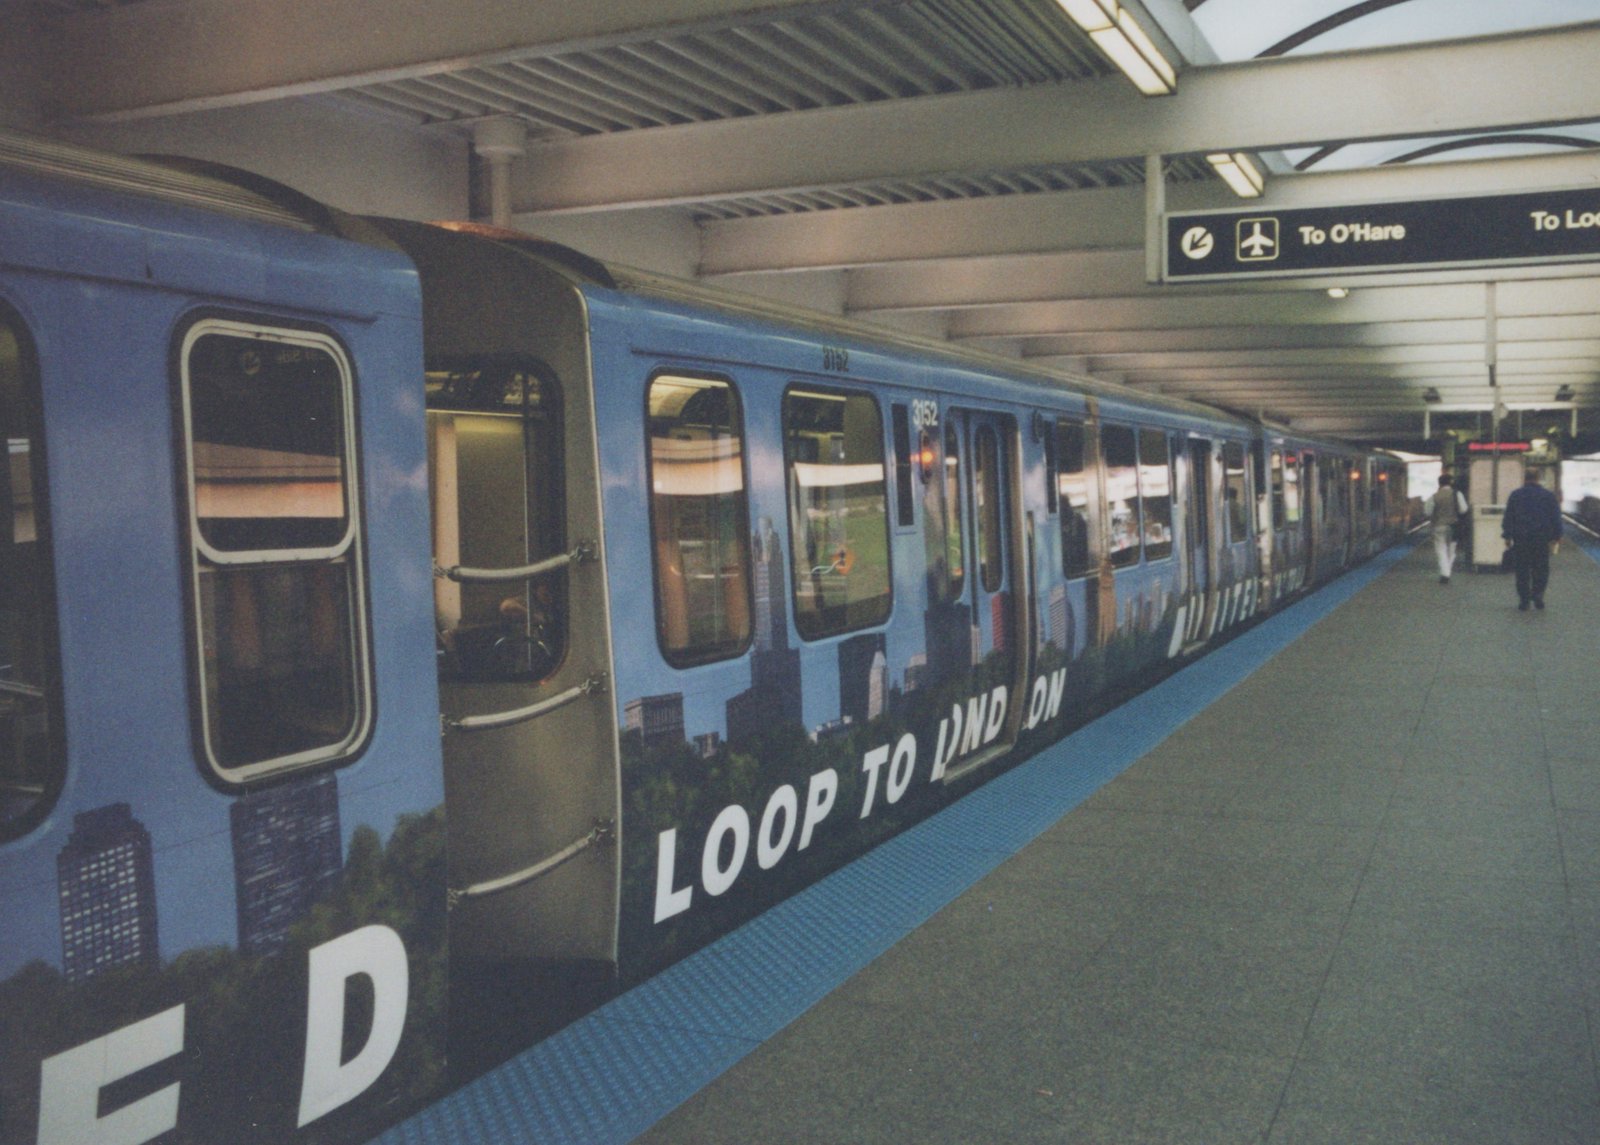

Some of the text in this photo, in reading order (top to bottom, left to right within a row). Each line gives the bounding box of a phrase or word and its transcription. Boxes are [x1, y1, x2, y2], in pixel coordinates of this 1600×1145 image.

[1531, 210, 1560, 231] To
[1299, 222, 1406, 245] To O'Hare
[913, 398, 938, 426] 3152
[653, 767, 838, 924] LOOP
[860, 732, 918, 819] TO
